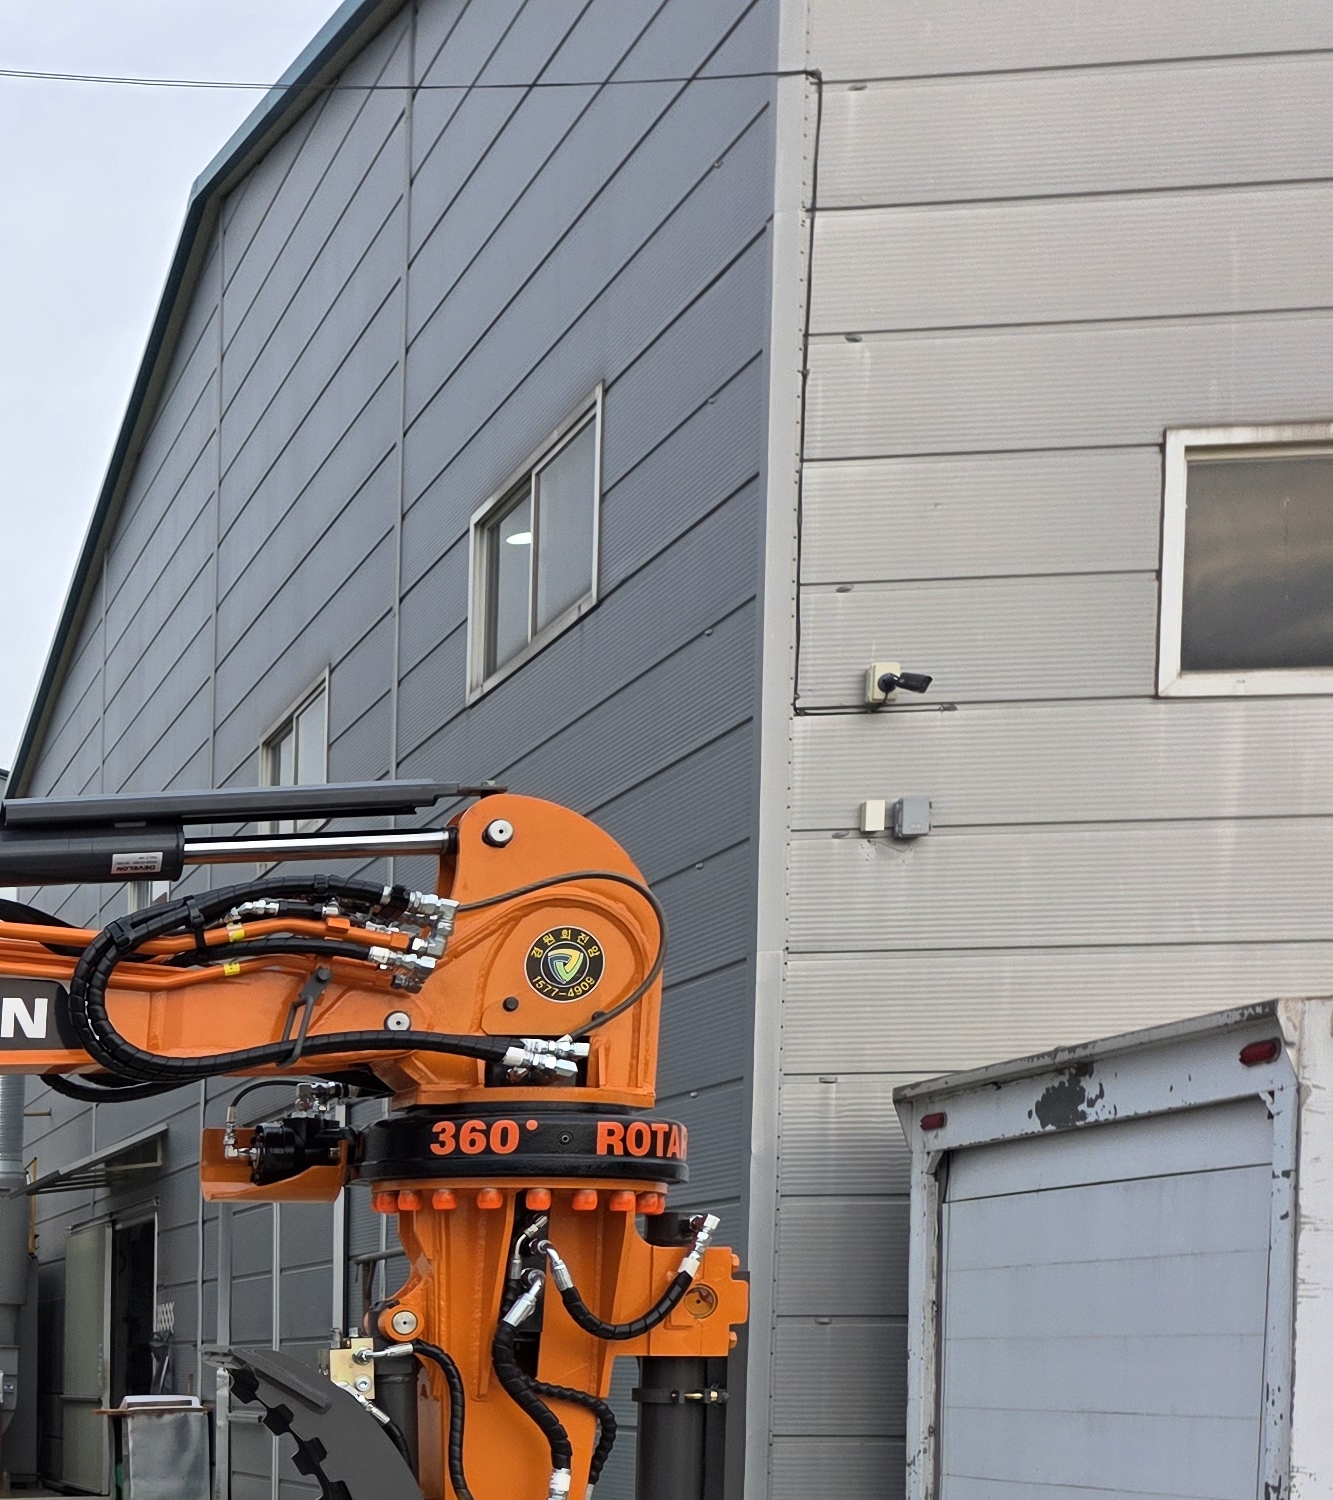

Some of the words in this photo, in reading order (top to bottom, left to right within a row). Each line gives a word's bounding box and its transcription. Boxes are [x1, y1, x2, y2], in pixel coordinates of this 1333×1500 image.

[116, 864, 156, 872] DEVELON
[532, 975, 596, 997] 1577-4909
[430, 1119, 538, 1156] 360°
